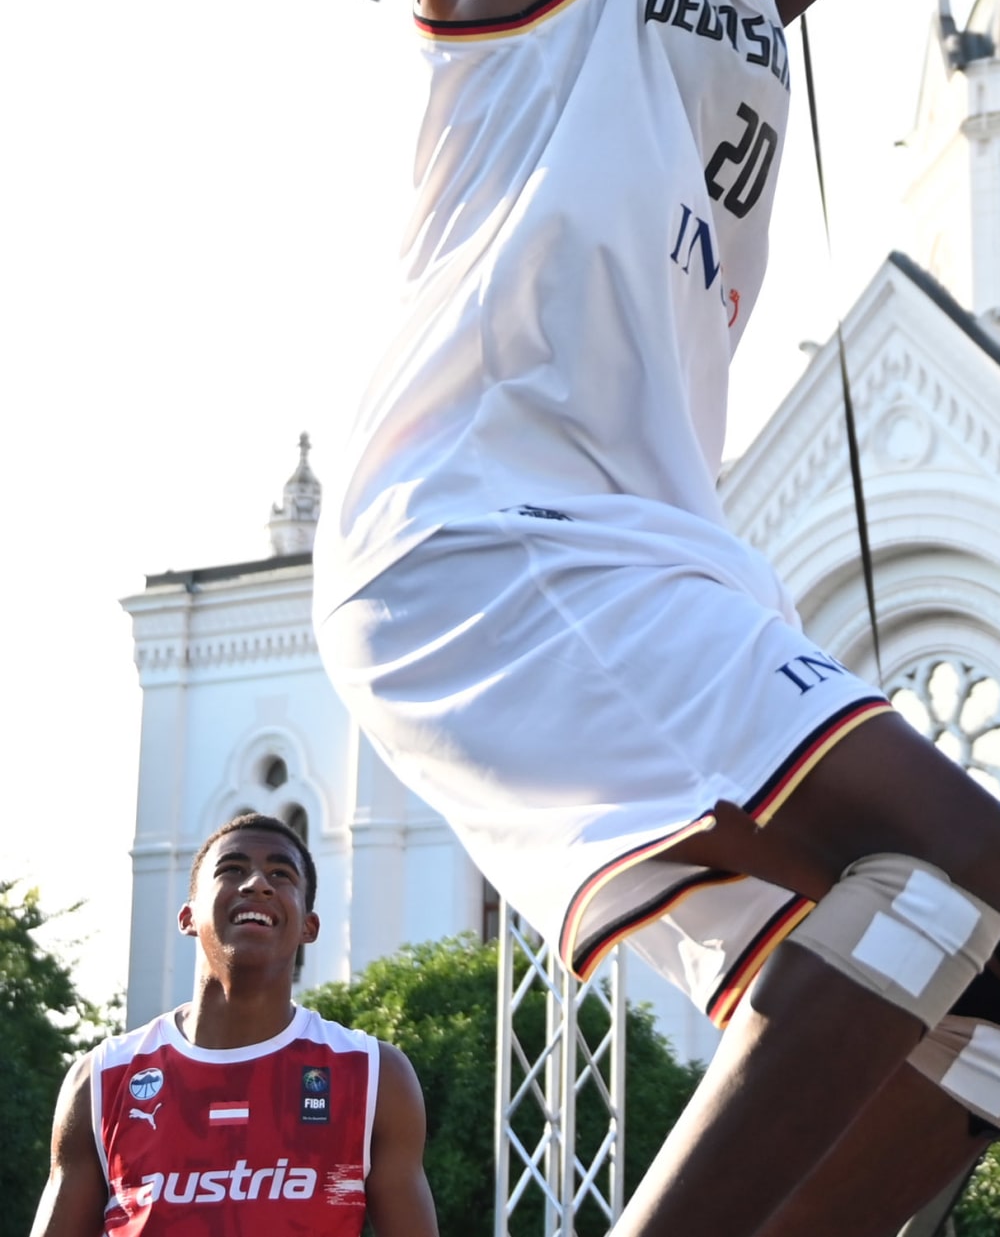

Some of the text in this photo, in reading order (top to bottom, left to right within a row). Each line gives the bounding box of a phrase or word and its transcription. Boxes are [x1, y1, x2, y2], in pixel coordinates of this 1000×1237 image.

[704, 101, 778, 219] 20
[670, 203, 726, 308] IN
[774, 651, 849, 695] IN
[304, 1097, 326, 1109] FIBA
[136, 1158, 318, 1207] austria
